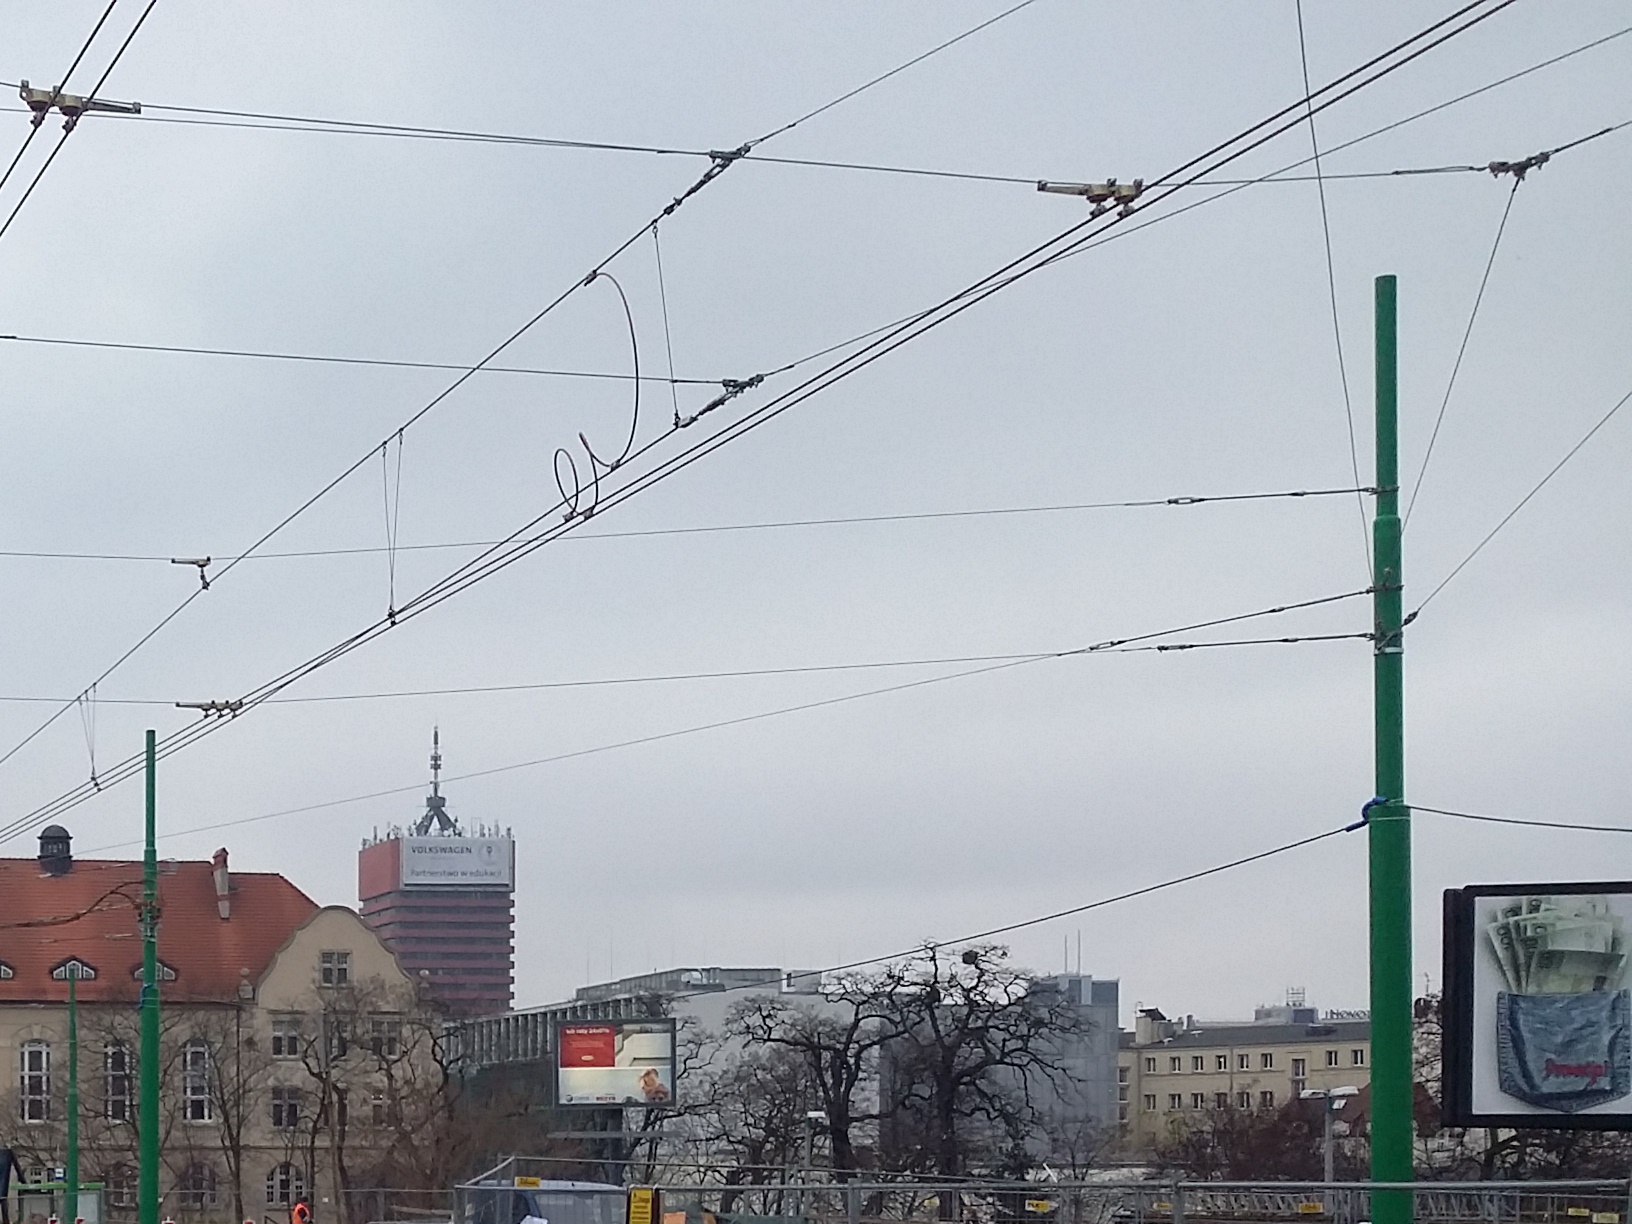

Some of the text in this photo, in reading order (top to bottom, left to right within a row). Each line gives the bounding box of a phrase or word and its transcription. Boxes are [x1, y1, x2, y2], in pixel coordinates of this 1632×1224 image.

[411, 845, 472, 854] VOLKSWAGEN
[411, 869, 458, 877] Partnerstwo
[469, 868, 502, 878] edukacji
[1330, 1009, 1371, 1020] NOVO
